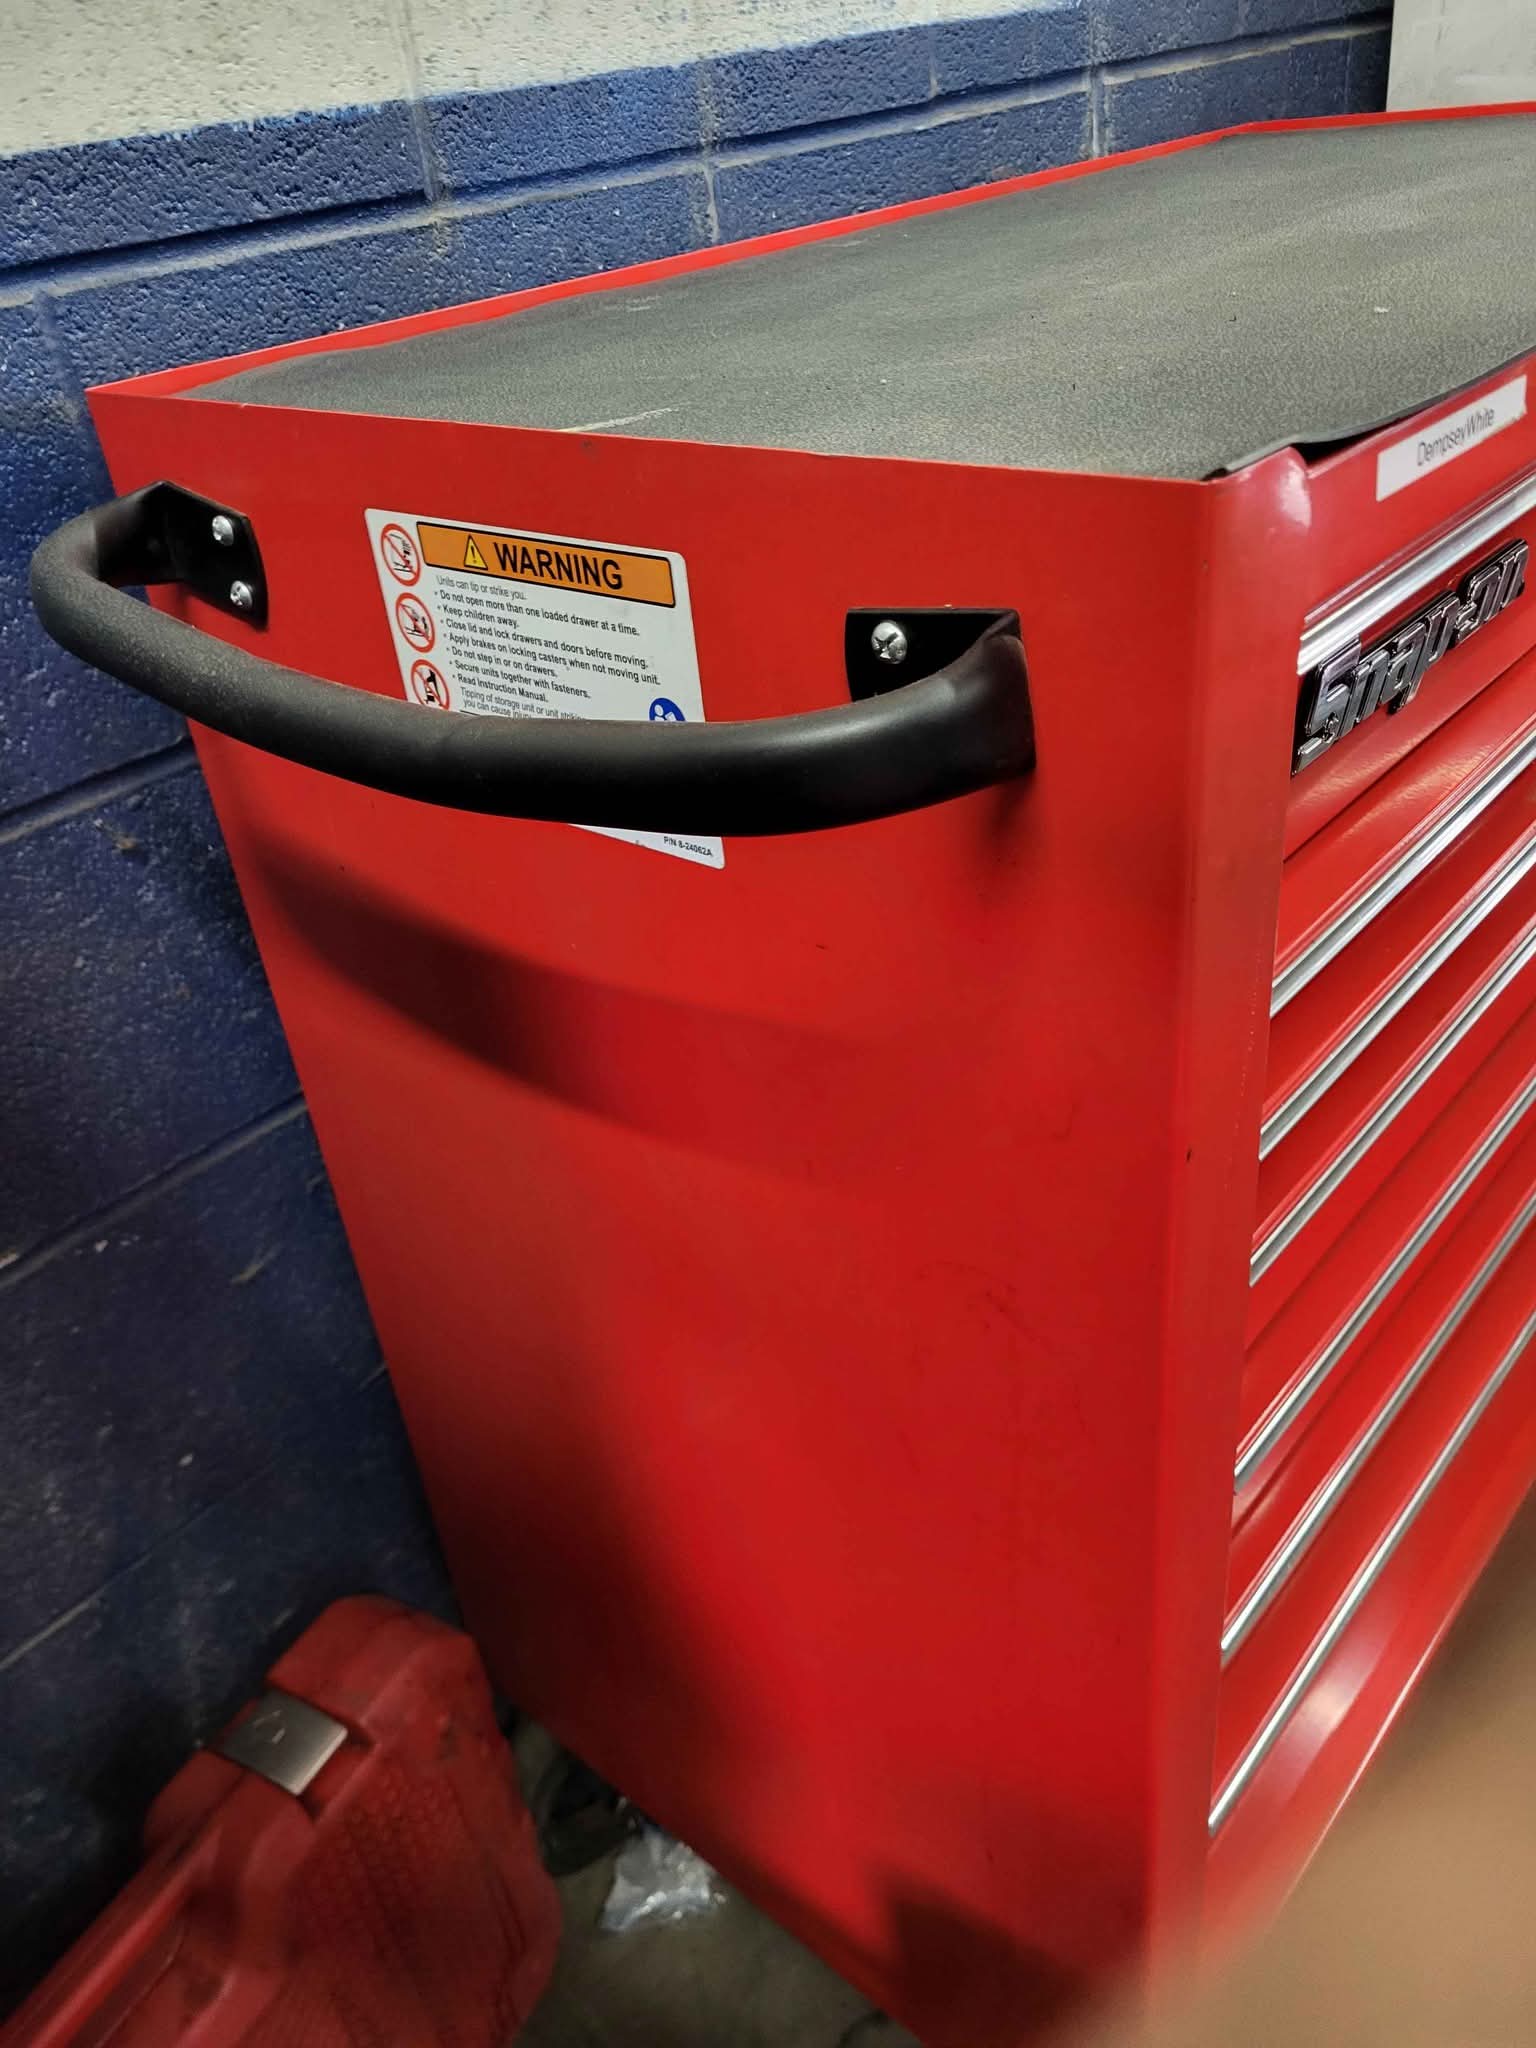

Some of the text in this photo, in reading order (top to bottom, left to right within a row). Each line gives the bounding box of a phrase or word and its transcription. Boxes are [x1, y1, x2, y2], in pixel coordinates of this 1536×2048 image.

[1416, 407, 1495, 467] Dempsey White
[494, 541, 623, 591] WARNING
[436, 575, 527, 600] Units can tip or strike you.
[440, 589, 640, 636] Do not open more than one loaded drawer at a time.
[443, 604, 520, 630] Keep children away.
[446, 618, 649, 670] Close lid and lock drawers and doors before moving.
[449, 632, 661, 686] Apply brakes on locking casters when not moving unit.
[452, 646, 558, 678] Do not step in or on drawers.
[455, 659, 591, 699] Secure units together with fasteners.
[458, 673, 549, 703] Read Instruction Manual.
[460, 686, 586, 720] Tipping of storage unit or unit striki
[464, 699, 476, 709] you
[477, 701, 489, 711] can
[490, 704, 511, 716] cause
[663, 836, 677, 847] P/N
